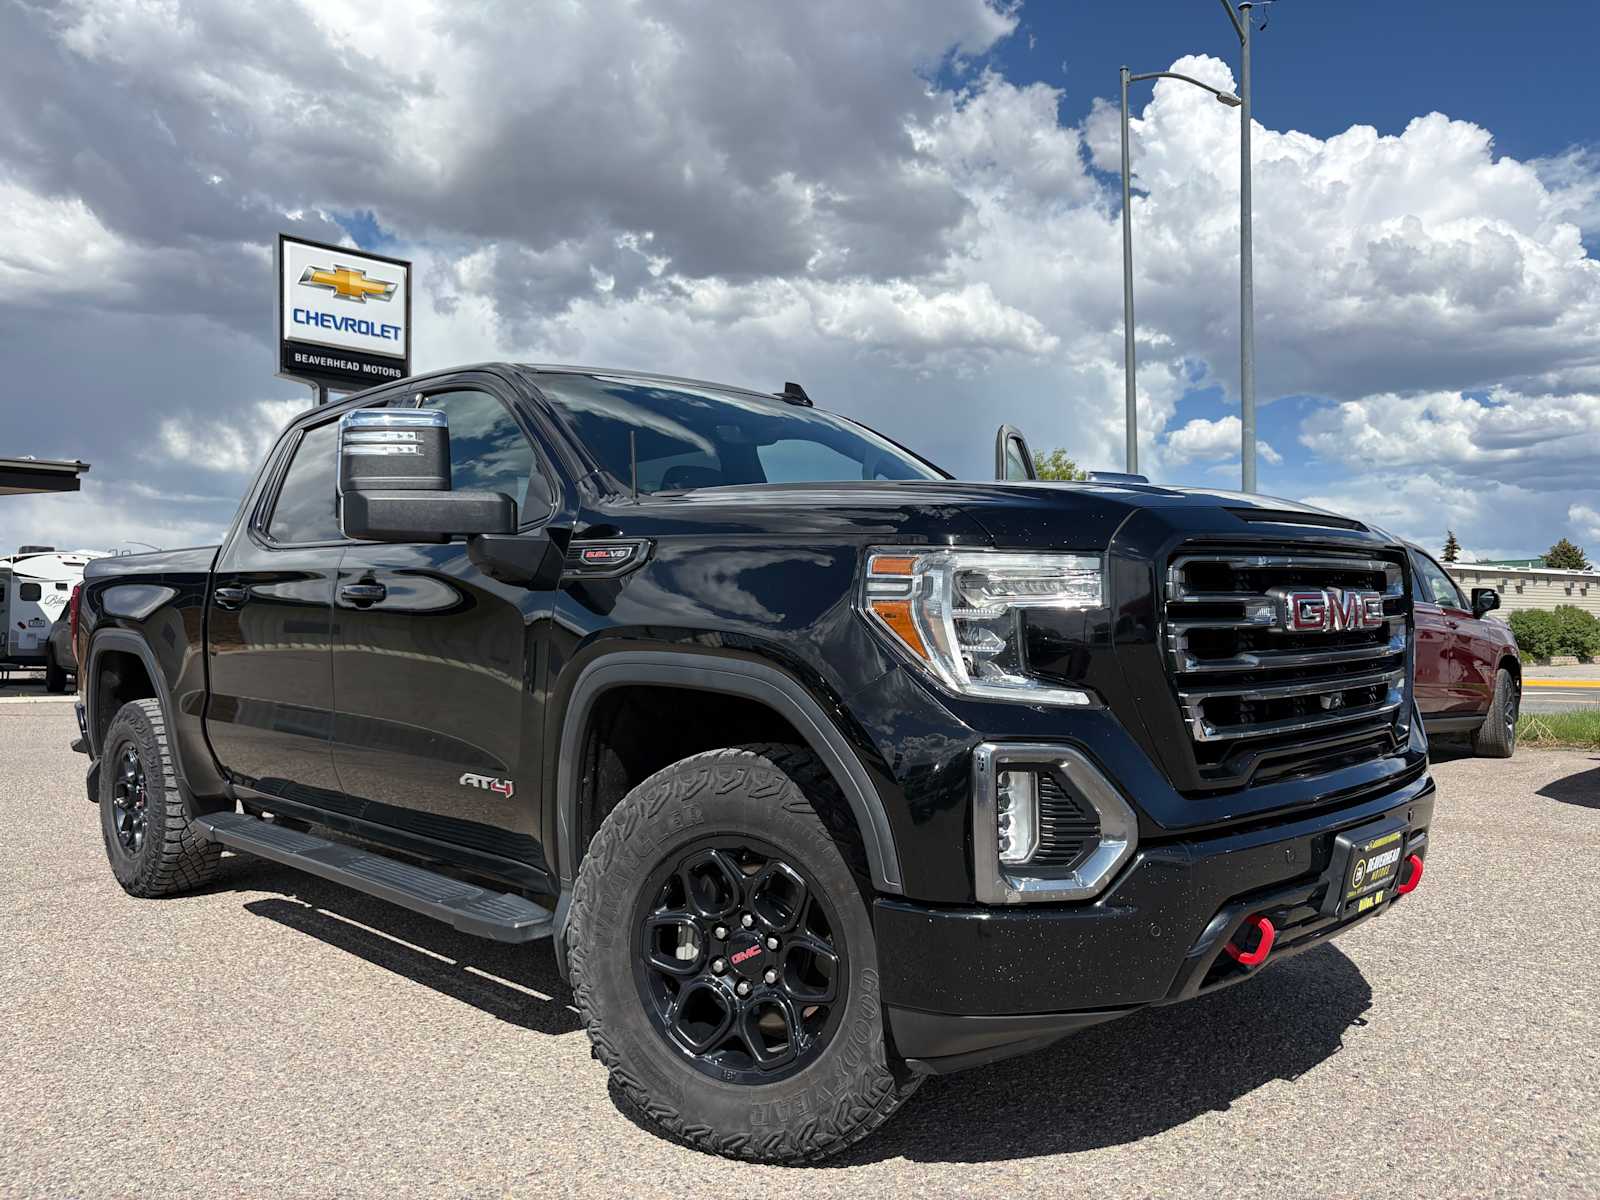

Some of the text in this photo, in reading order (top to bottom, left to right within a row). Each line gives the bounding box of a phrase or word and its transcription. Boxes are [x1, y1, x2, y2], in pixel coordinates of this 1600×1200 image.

[293, 307, 401, 341] CHEVROLET
[294, 352, 402, 378] BEAVERHEAD MOTORS
[1286, 590, 1382, 632] GMC
[459, 772, 514, 799] AT4
[731, 944, 762, 965] GMC
